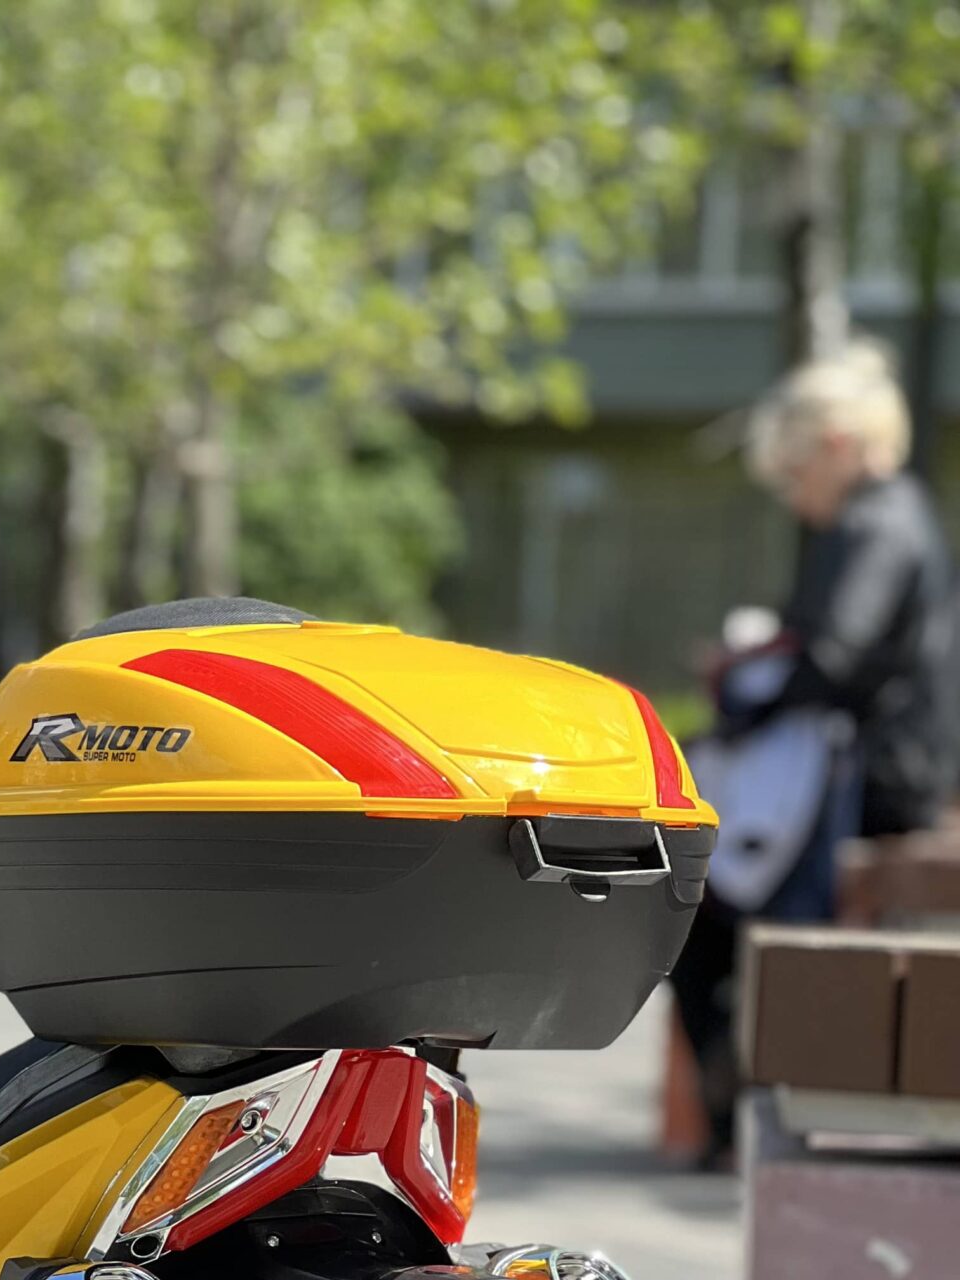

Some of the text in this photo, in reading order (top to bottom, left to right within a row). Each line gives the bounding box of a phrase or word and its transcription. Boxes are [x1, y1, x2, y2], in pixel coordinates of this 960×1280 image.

[77, 725, 192, 752] MOTO
[83, 751, 136, 762] SUPER MOTO
